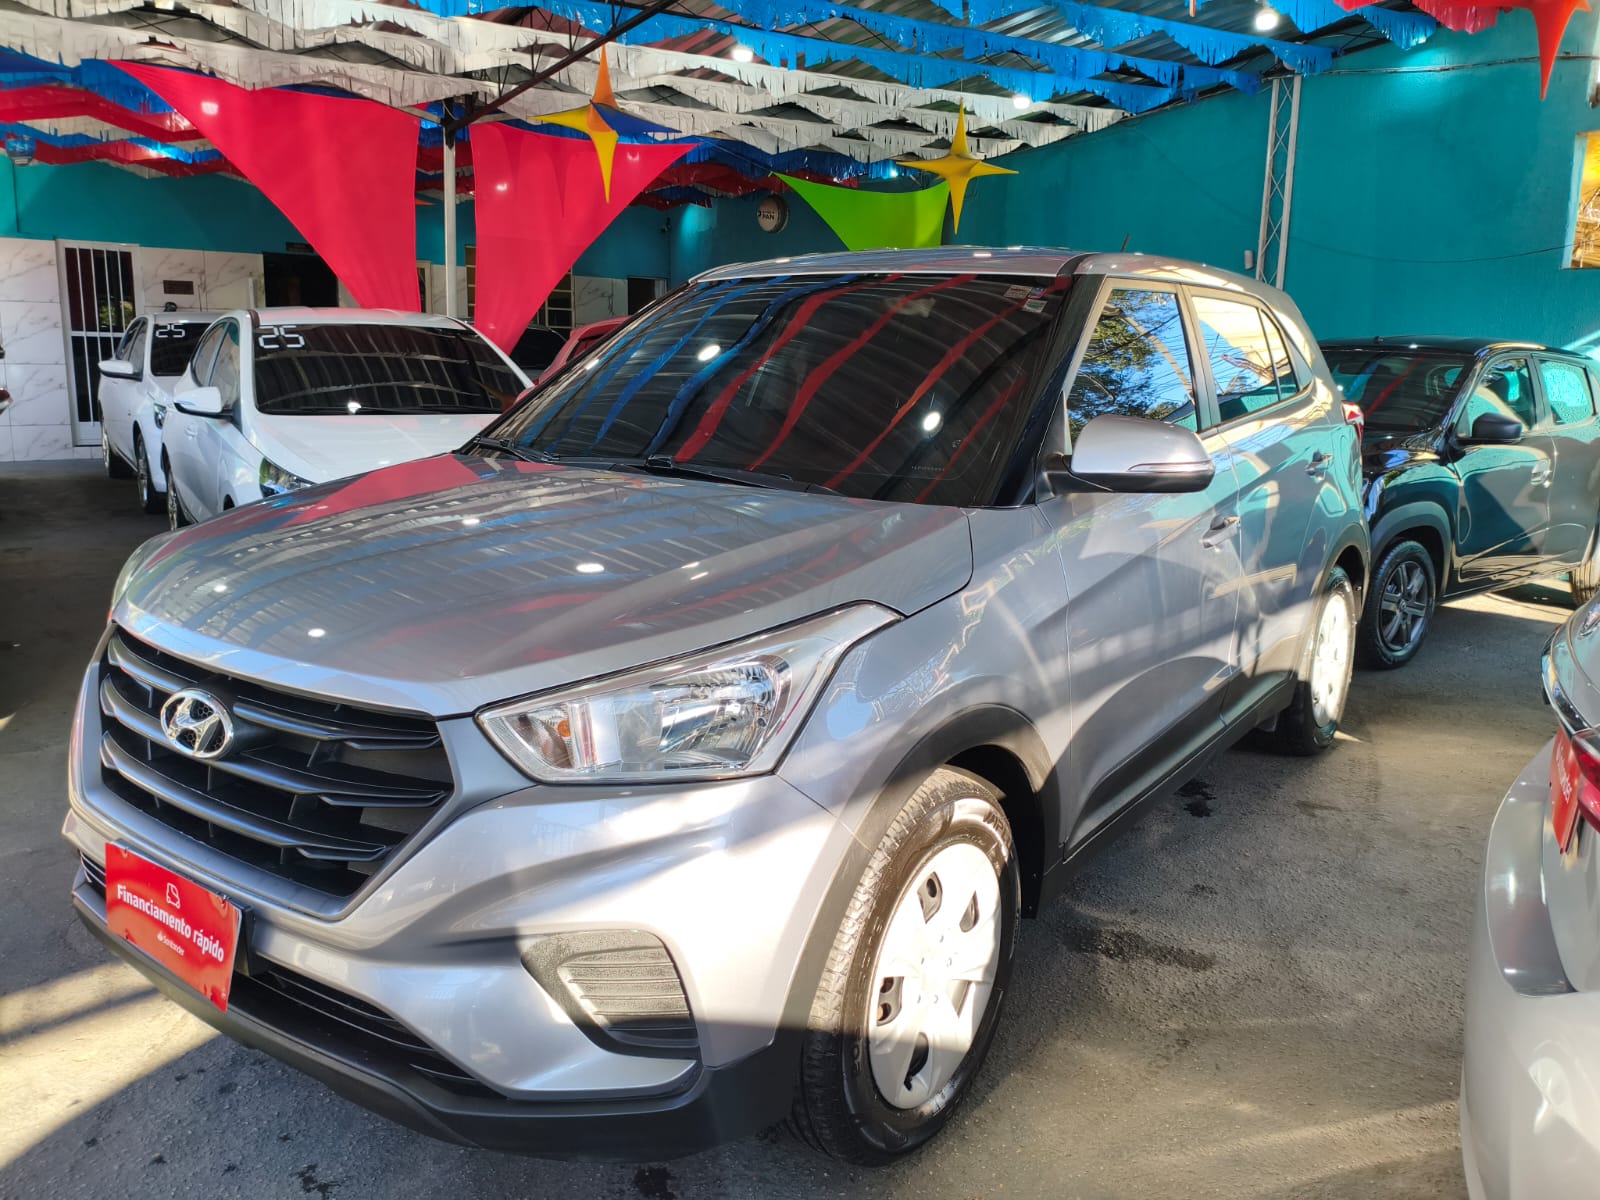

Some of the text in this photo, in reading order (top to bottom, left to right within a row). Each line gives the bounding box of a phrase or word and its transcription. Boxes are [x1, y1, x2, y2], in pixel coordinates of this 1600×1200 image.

[156, 323, 186, 338] 25
[258, 325, 305, 349] 25
[117, 884, 225, 962] Financiamento rápido
